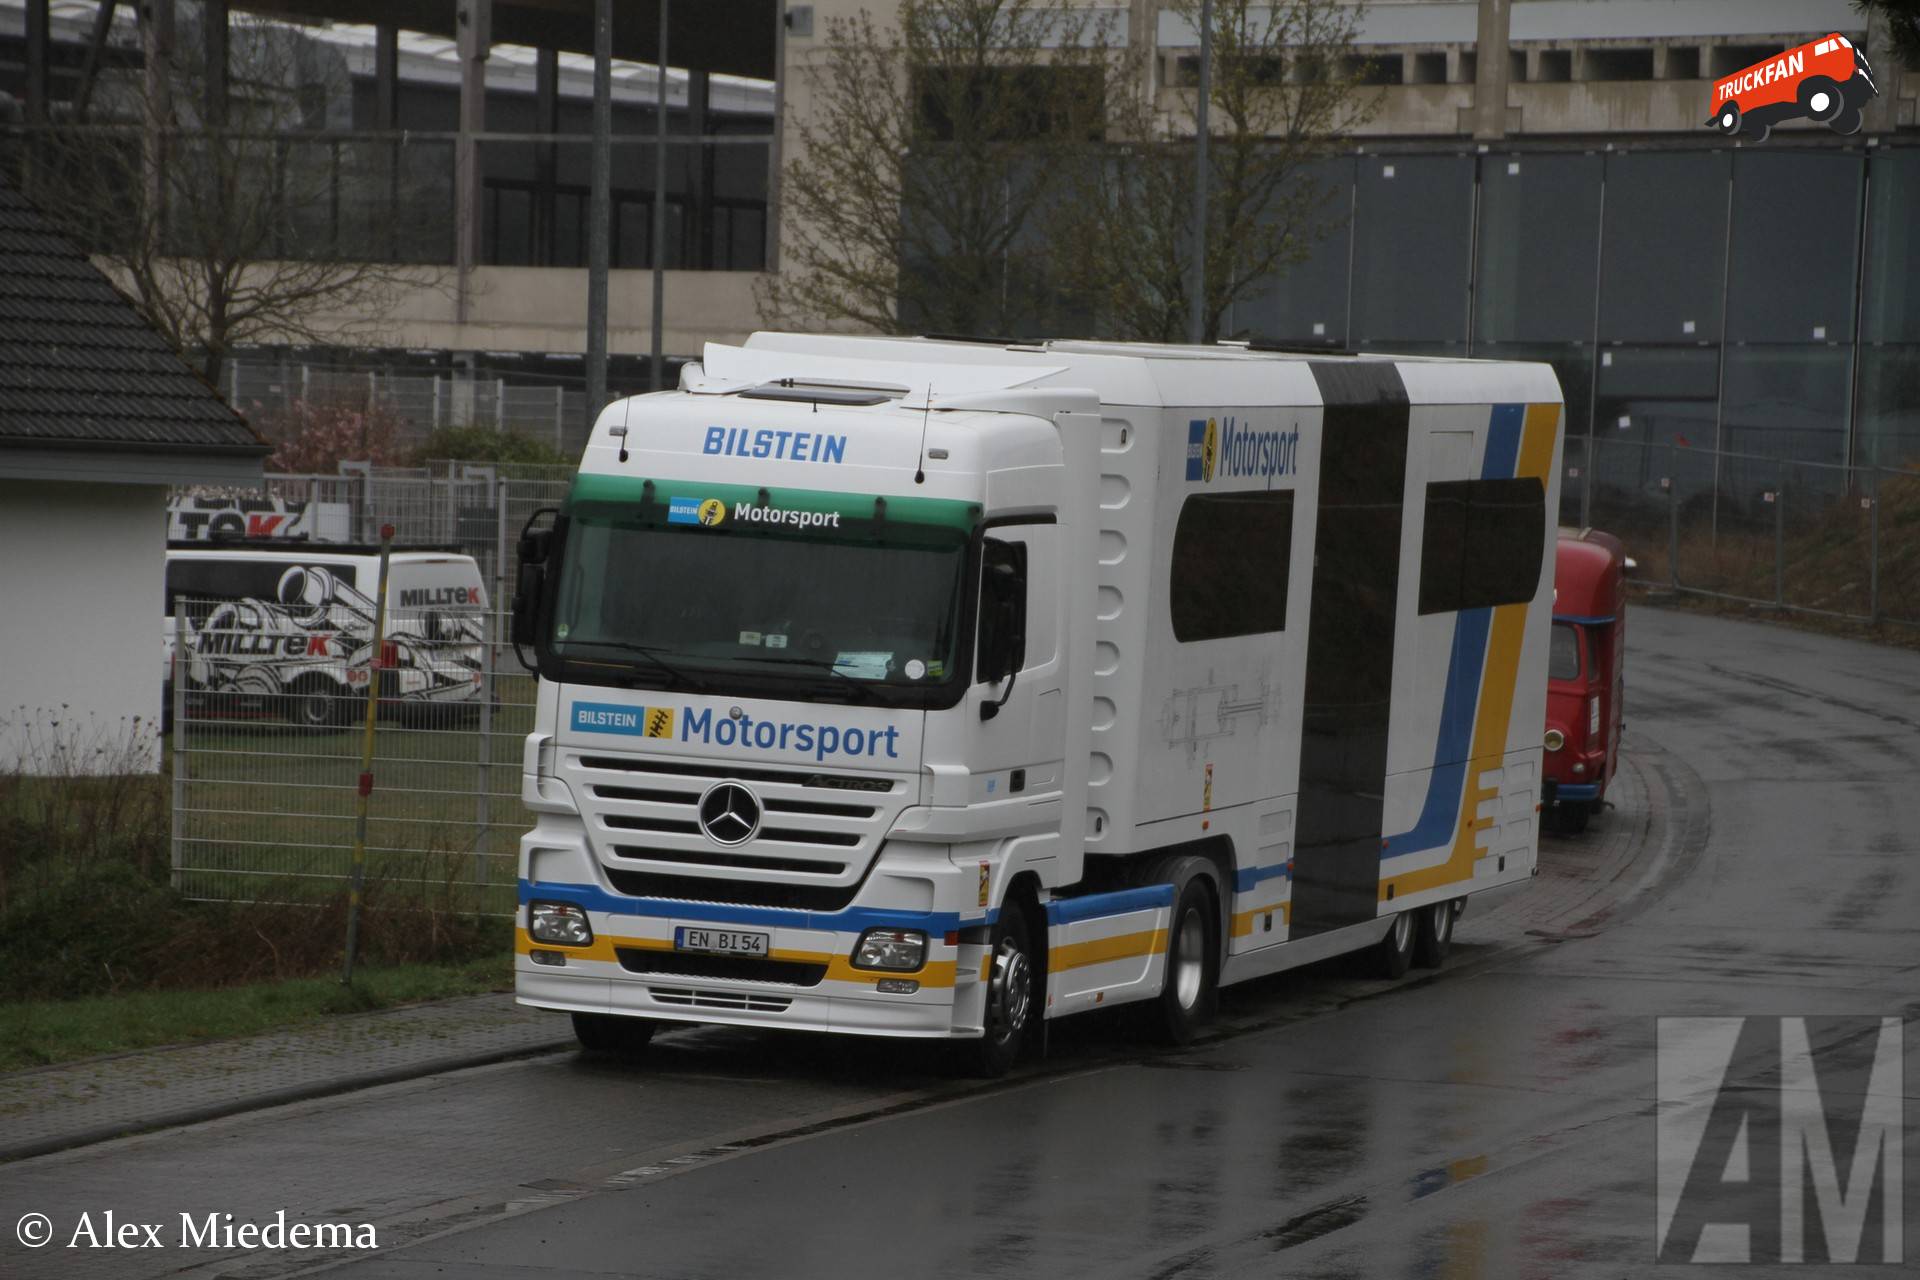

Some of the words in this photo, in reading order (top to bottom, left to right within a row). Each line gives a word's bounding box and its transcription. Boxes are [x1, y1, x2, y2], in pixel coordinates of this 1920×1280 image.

[702, 426, 847, 464] BILSTEIN
[1219, 416, 1299, 491] Motorsport
[669, 504, 698, 515] BILSTEIN
[734, 502, 840, 529] Motorsport
[578, 710, 637, 728] BILSTEIN
[681, 706, 899, 761] Motorsport
[689, 931, 709, 947] EN
[719, 933, 737, 950] BI
[741, 935, 760, 951] 54
